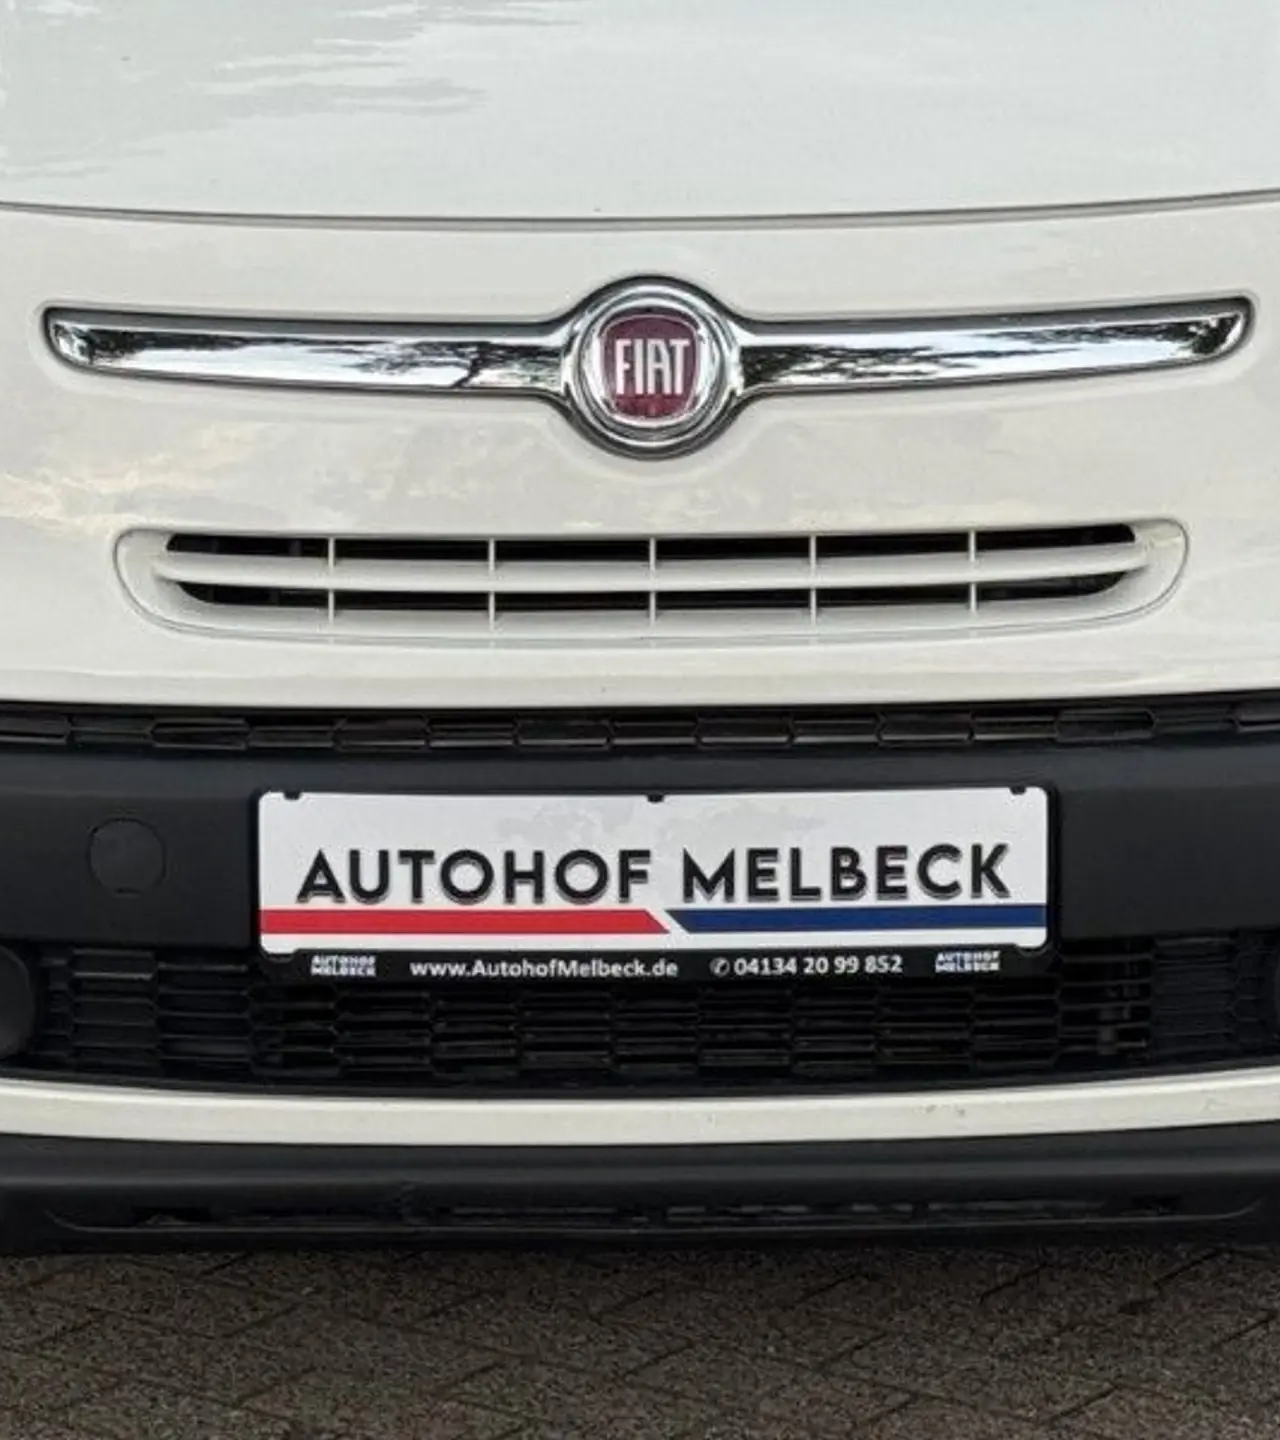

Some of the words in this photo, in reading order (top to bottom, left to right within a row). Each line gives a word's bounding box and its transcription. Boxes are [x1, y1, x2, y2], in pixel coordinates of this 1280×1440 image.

[615, 338, 690, 396] FIAT
[296, 848, 652, 906] AUTOHOF
[682, 843, 1011, 903] MELBECK
[409, 958, 679, 979] www.AutohofMelbeck.de
[733, 957, 798, 976] 04134
[803, 957, 829, 975] 20
[834, 955, 860, 974] 99
[864, 955, 903, 974] 852
